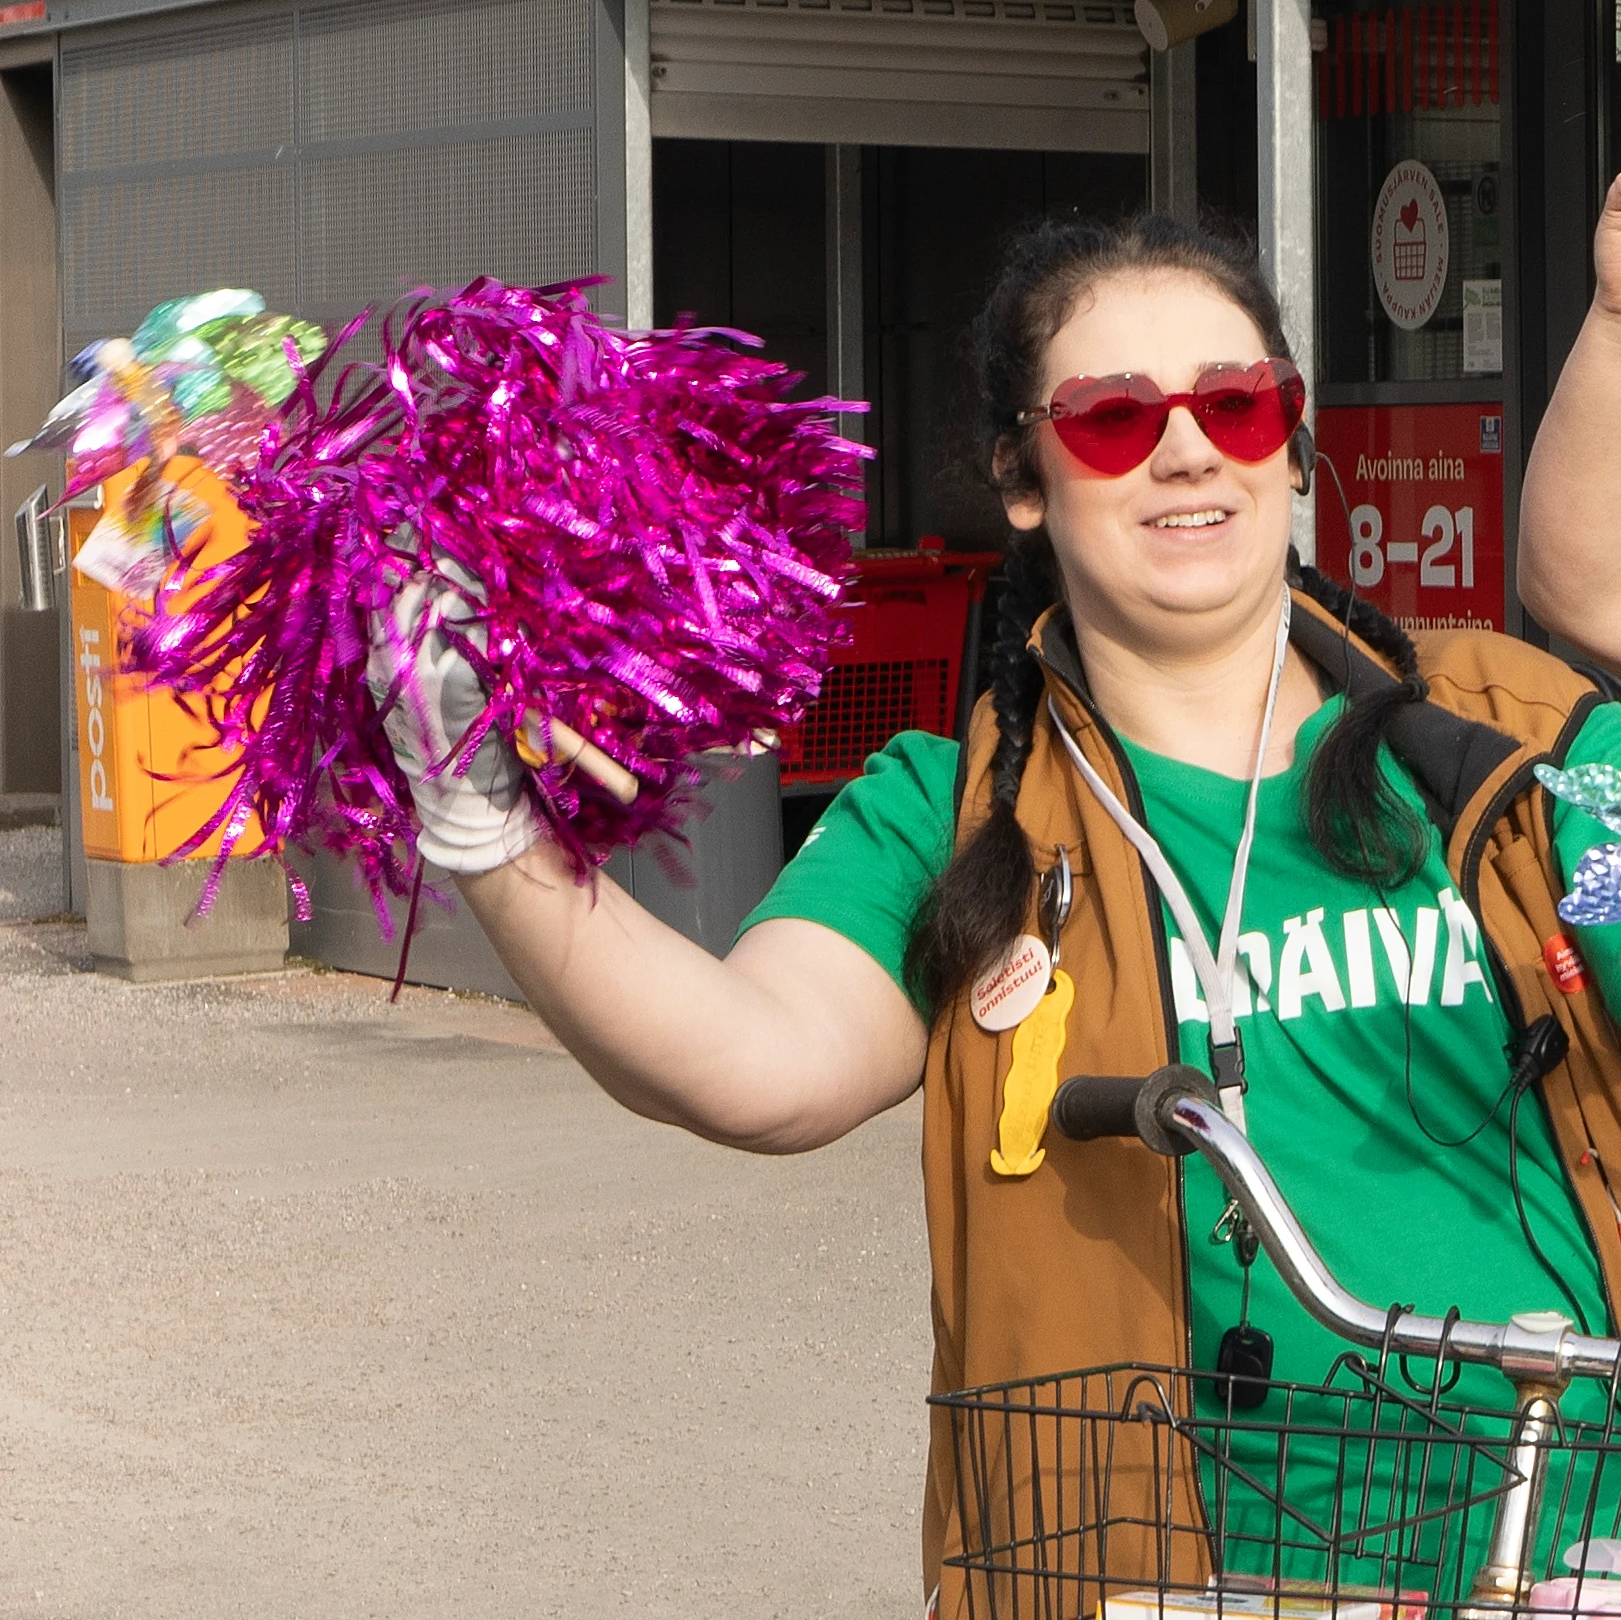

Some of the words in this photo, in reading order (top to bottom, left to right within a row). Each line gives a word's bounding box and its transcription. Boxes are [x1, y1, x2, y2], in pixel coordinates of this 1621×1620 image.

[1428, 188, 1445, 234] SALE
[1382, 280, 1417, 320] KAUPPA
[1355, 449, 1424, 481] Avoinna
[1428, 449, 1466, 481] aina
[80, 623, 114, 812] posti
[978, 960, 1043, 1019] onnistuu!
